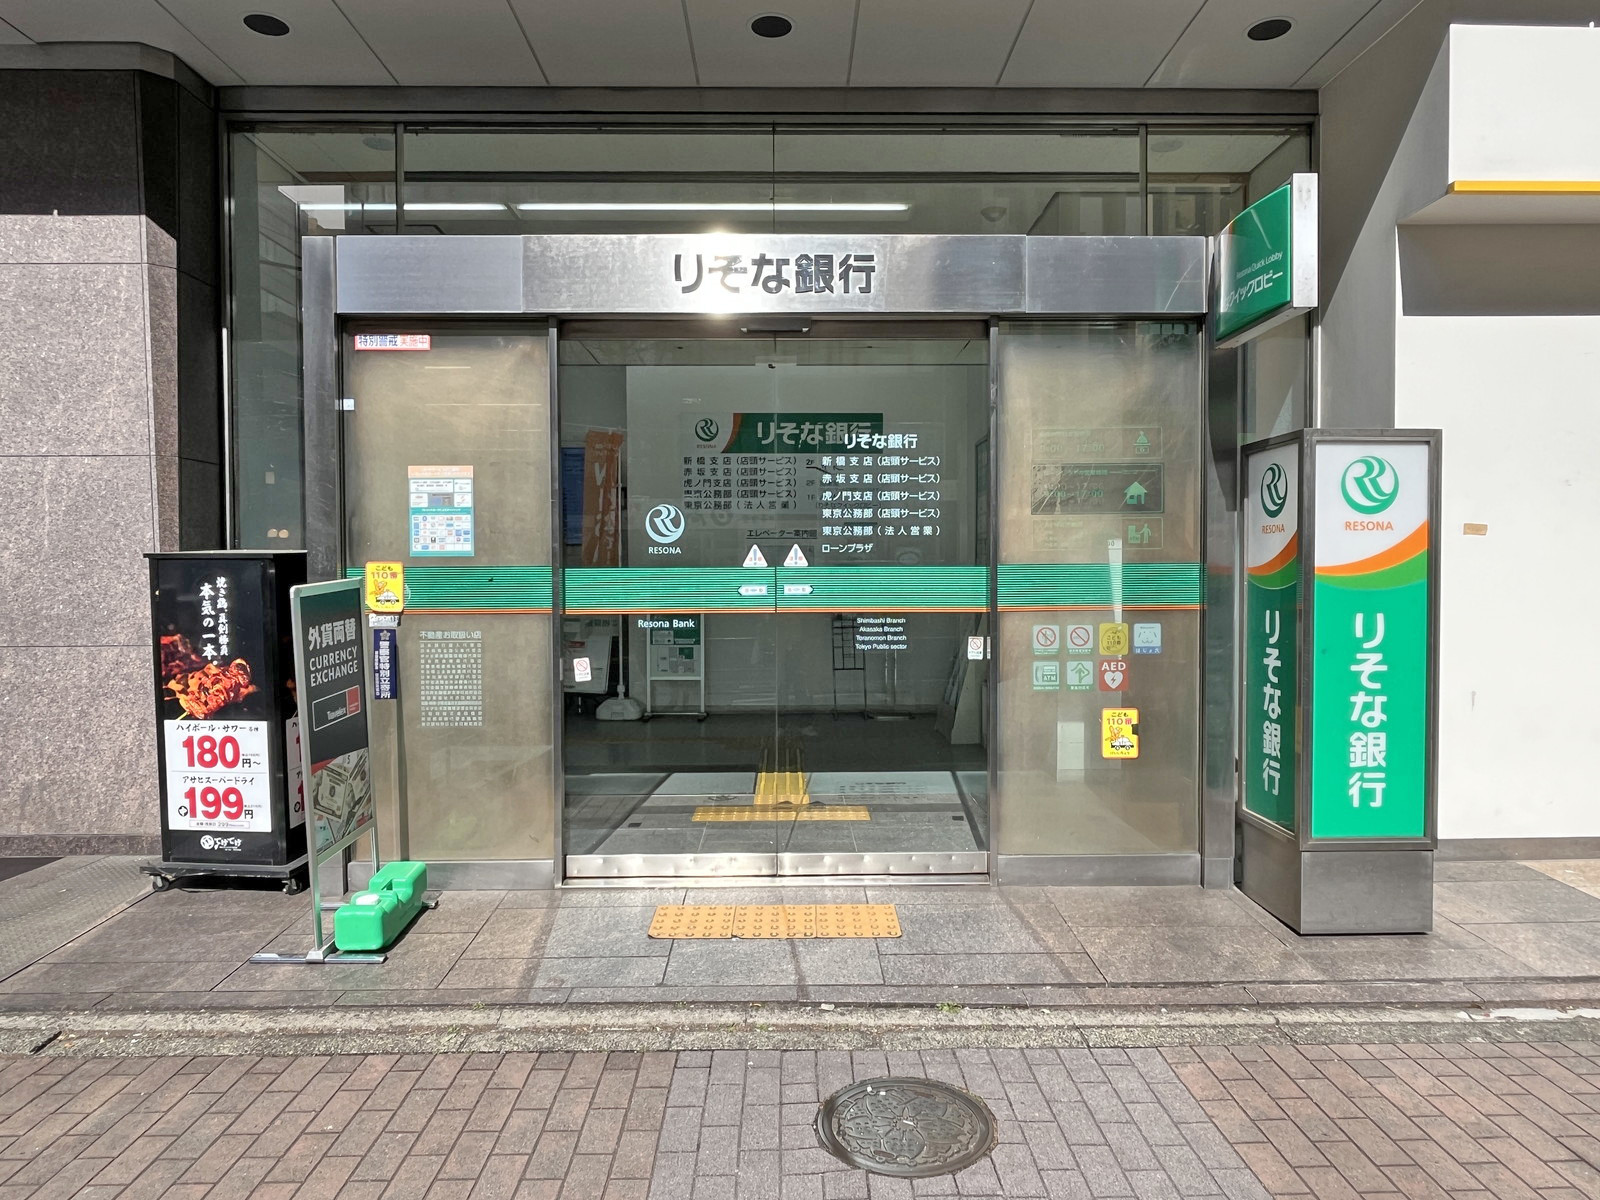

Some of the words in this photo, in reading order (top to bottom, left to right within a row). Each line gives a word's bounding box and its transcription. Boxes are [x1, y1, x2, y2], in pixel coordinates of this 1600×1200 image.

[1266, 251, 1283, 264] Lobby
[674, 253, 876, 294] りそな銀行
[844, 433, 918, 449] りそな銀行
[1261, 523, 1285, 534] RESONA
[1344, 521, 1394, 531] RESONA
[648, 546, 682, 555] RESONA
[822, 543, 873, 553] ローンプラザ
[637, 619, 670, 628] Resona
[672, 619, 696, 628] Bank
[308, 617, 356, 651] 外貨両替
[309, 646, 358, 671] CURRENCY
[1101, 662, 1126, 671] AED
[310, 660, 358, 687] EXCHANGE
[1262, 609, 1282, 796] りそな銀行
[1348, 612, 1388, 808] りそな銀行
[182, 776, 255, 786] アサヒスーパードライ
